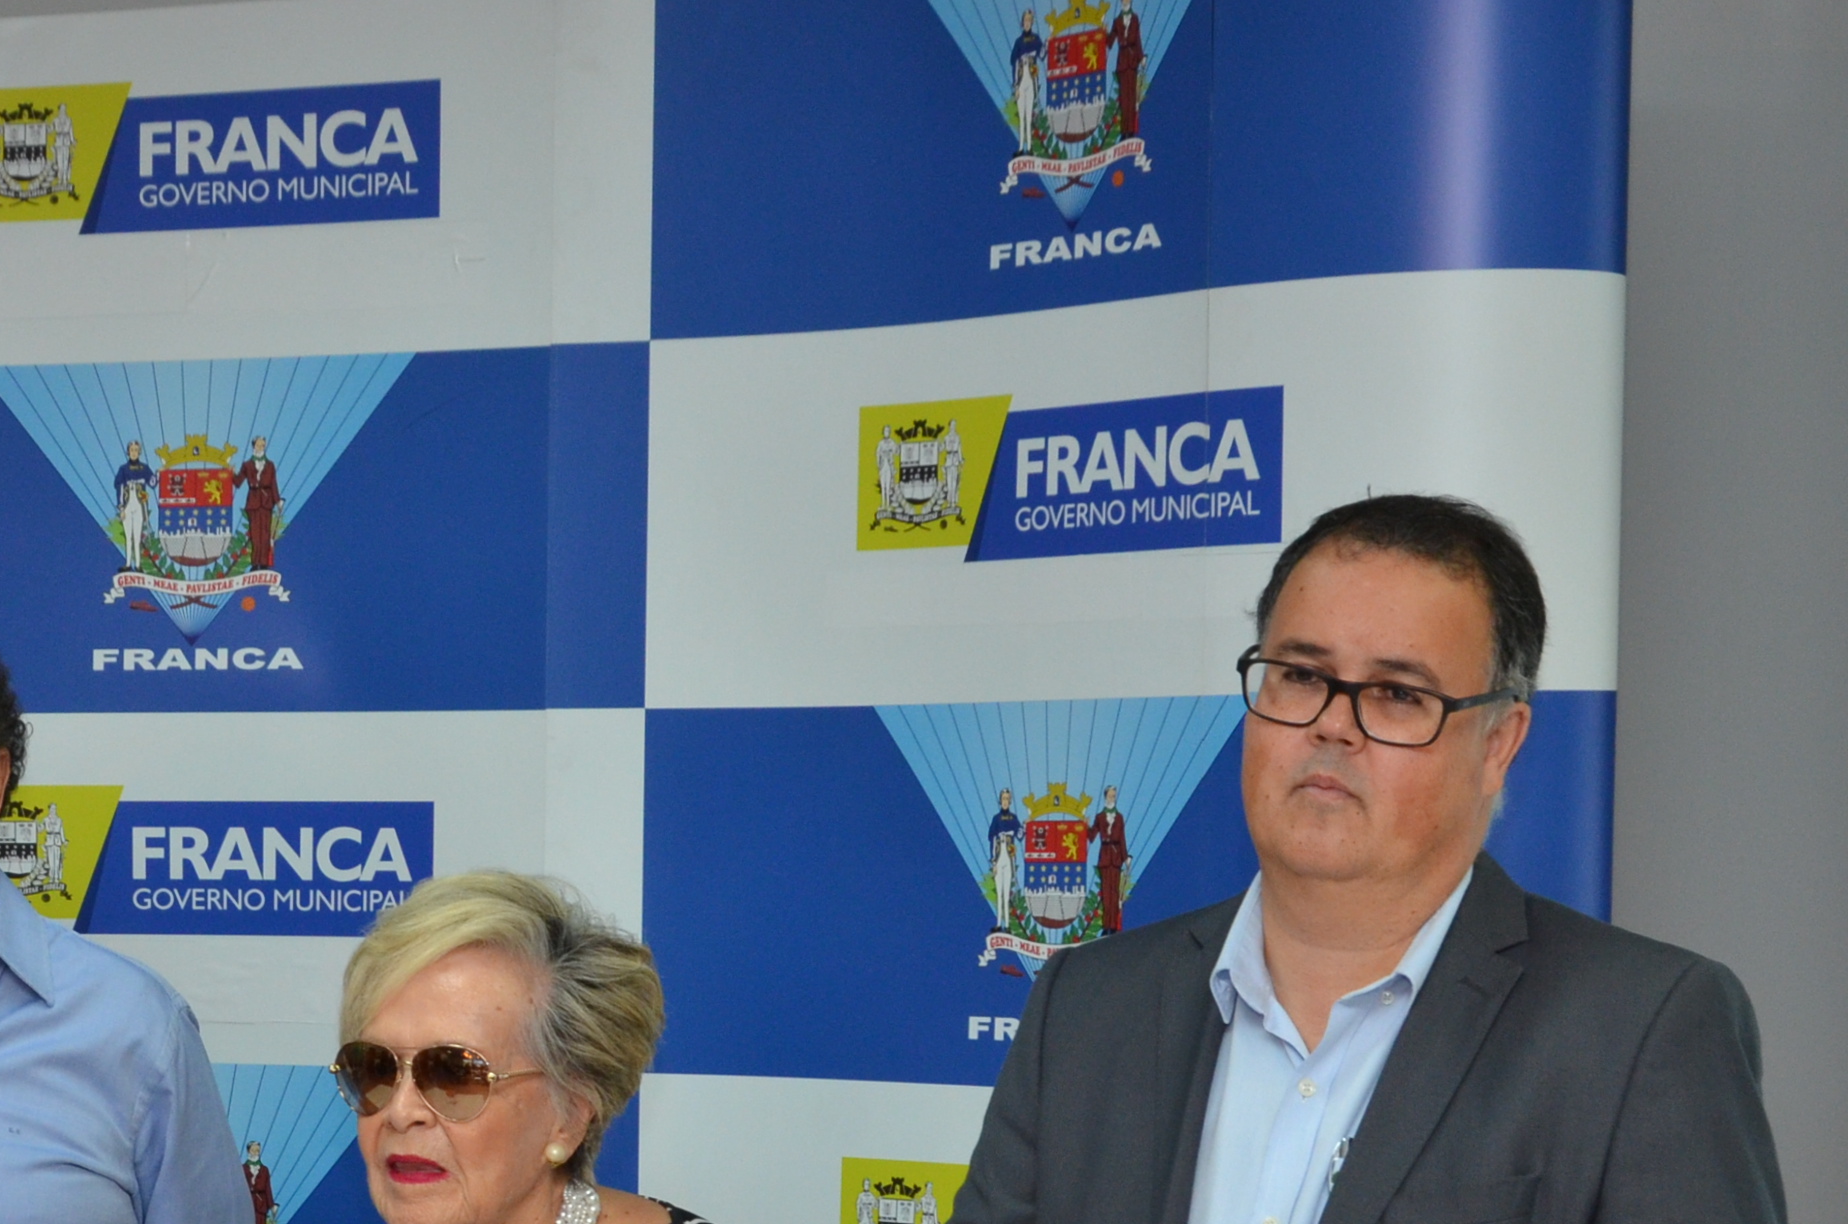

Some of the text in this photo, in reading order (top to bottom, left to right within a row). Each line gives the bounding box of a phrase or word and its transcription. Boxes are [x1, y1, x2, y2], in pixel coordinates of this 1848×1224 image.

[139, 107, 418, 177] FRANCA
[139, 171, 418, 208] GOVERNO MUNICIPAL
[990, 223, 1162, 270] FRANCA
[1016, 419, 1261, 498] FRANCA
[1015, 490, 1261, 532] GOVERNO MUNICIPAL
[117, 575, 146, 587] GENTI
[241, 573, 278, 586] FIDELIS
[92, 647, 304, 671] FRANCA
[131, 826, 413, 882] FRANCA
[132, 887, 266, 911] GOVERNO
[990, 937, 1013, 949] GENTI
